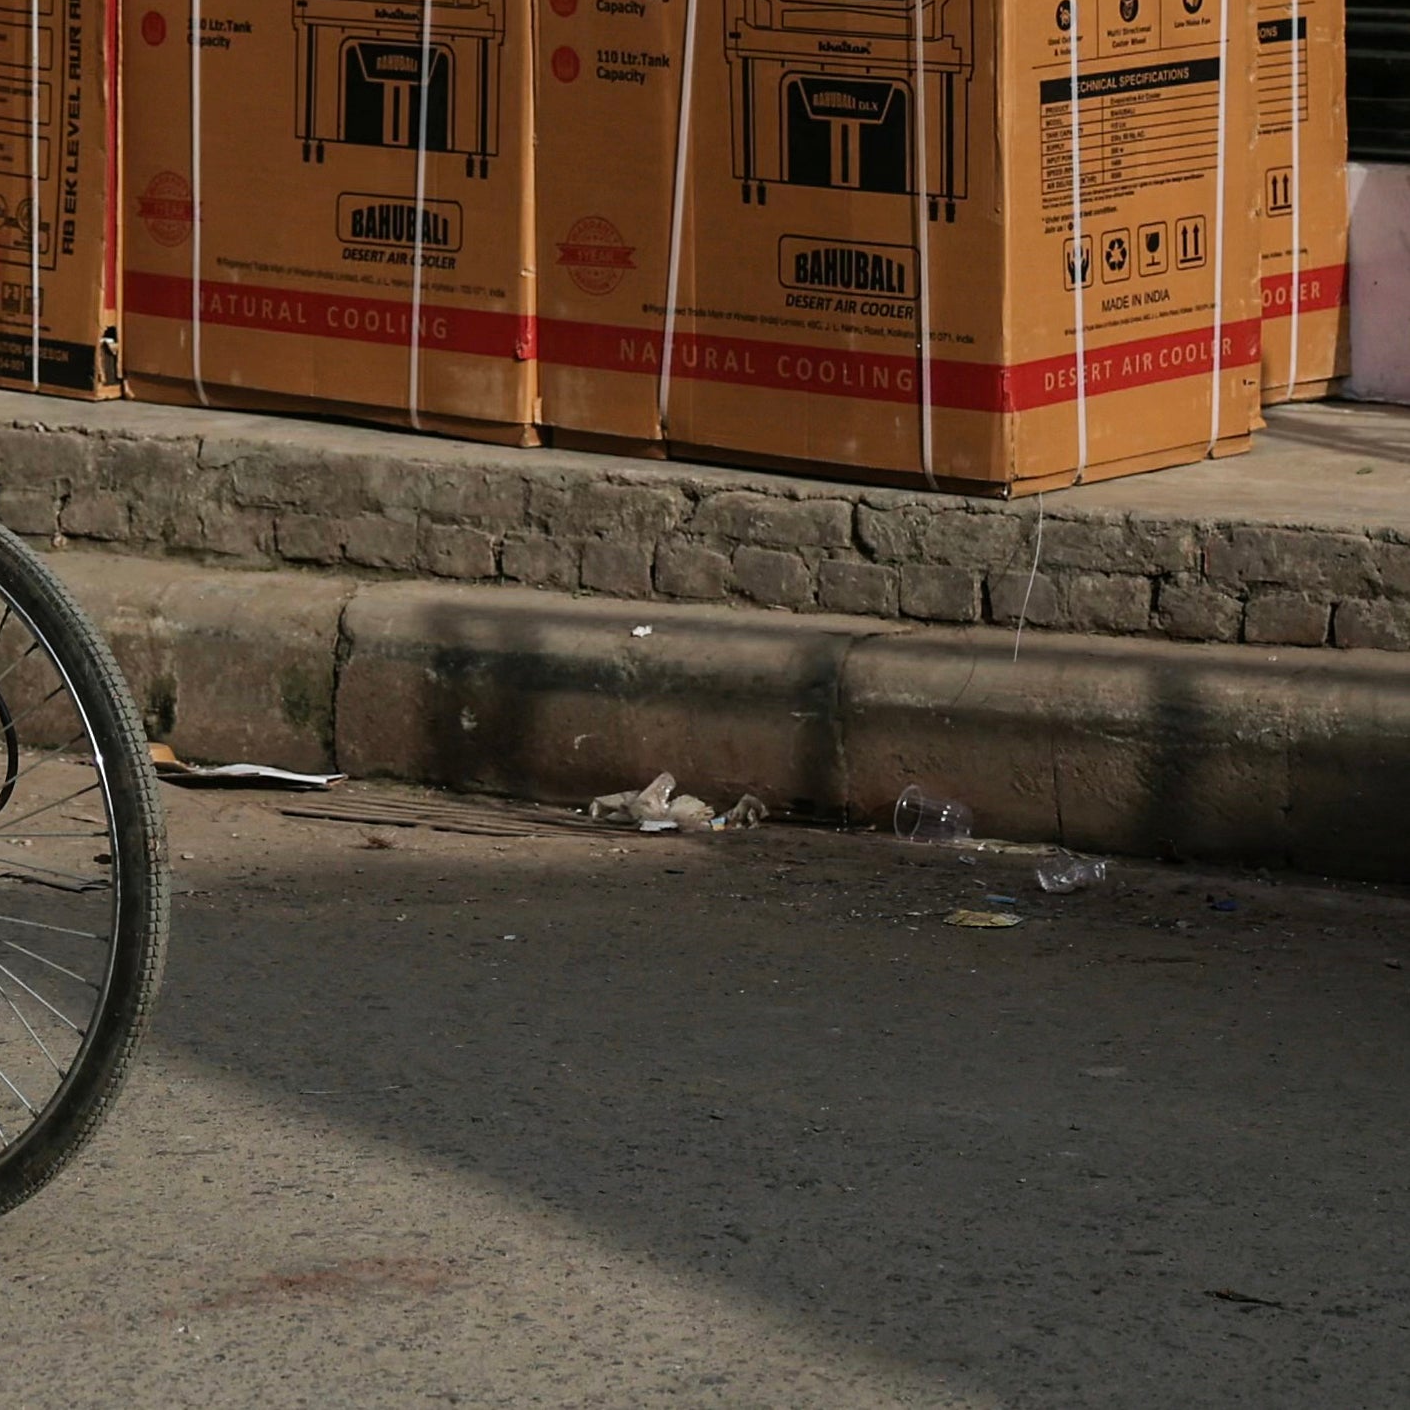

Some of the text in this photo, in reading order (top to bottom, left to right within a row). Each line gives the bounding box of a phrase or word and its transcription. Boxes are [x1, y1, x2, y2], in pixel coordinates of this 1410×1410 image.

[596, 0, 646, 17] Capacity
[208, 18, 253, 35] Ltr.Tank
[597, 49, 670, 68] 110 Ltr.Tank
[596, 66, 646, 85] Capacity
[1119, 66, 1190, 88] SPECIFICATIONS
[858, 101, 878, 111] DLX
[66, 86, 80, 175] LEVEL
[351, 204, 448, 245] BAHUBALI
[342, 247, 457, 270] DESERT AIR COLER
[794, 248, 905, 294] BAHUBALI
[785, 293, 914, 321] DESERT AIR COOLER
[1101, 289, 1170, 312] MADE IN INDIA
[197, 290, 448, 340] NATURAL COOLING
[777, 354, 914, 391] COOLING
[1044, 337, 1232, 391] DESERT AIR COOLR
